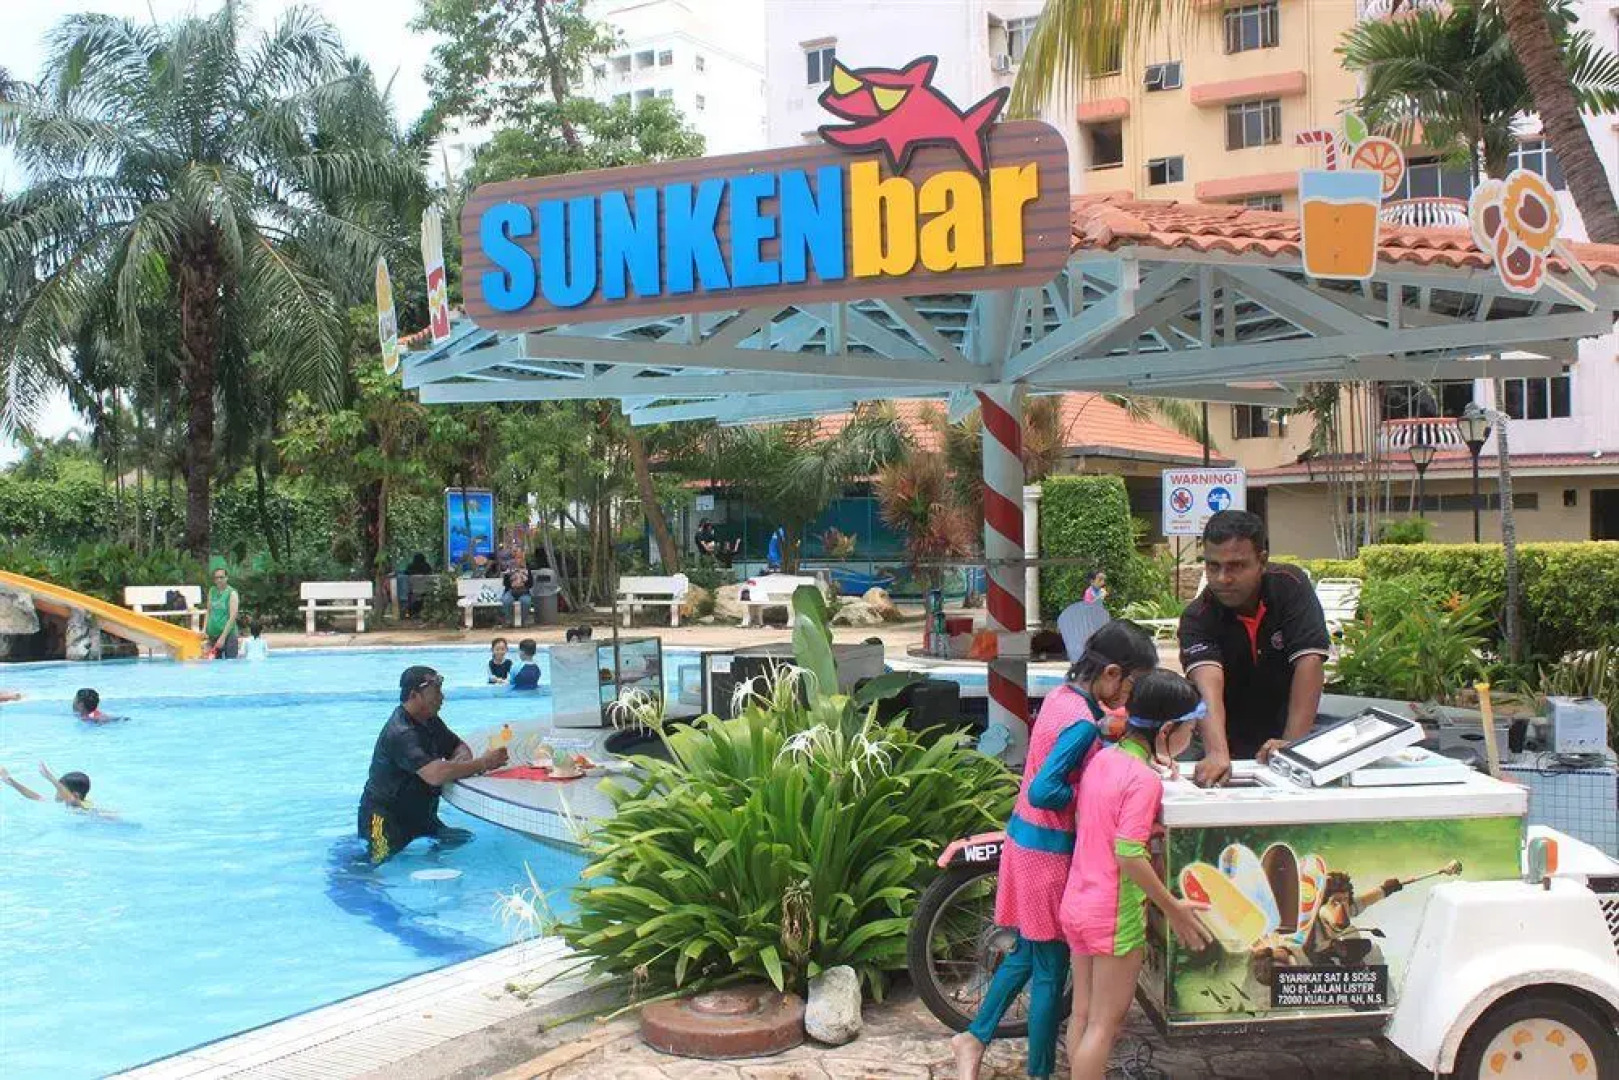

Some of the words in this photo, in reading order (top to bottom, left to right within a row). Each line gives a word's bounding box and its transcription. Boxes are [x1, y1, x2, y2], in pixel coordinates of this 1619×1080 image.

[478, 165, 845, 312] SUNKEN
[849, 160, 1039, 279] bar
[1170, 473, 1238, 485] WARNING!
[965, 844, 998, 862] WEP
[1278, 973, 1321, 983] SYARIKAT
[1324, 973, 1341, 982] SAT
[1343, 973, 1349, 983] &
[1282, 984, 1296, 994] NO
[1312, 983, 1341, 993] JALAN
[1343, 982, 1375, 993] LISTER
[1278, 995, 1302, 1005] 72000
[1304, 995, 1335, 1005] KUALA
